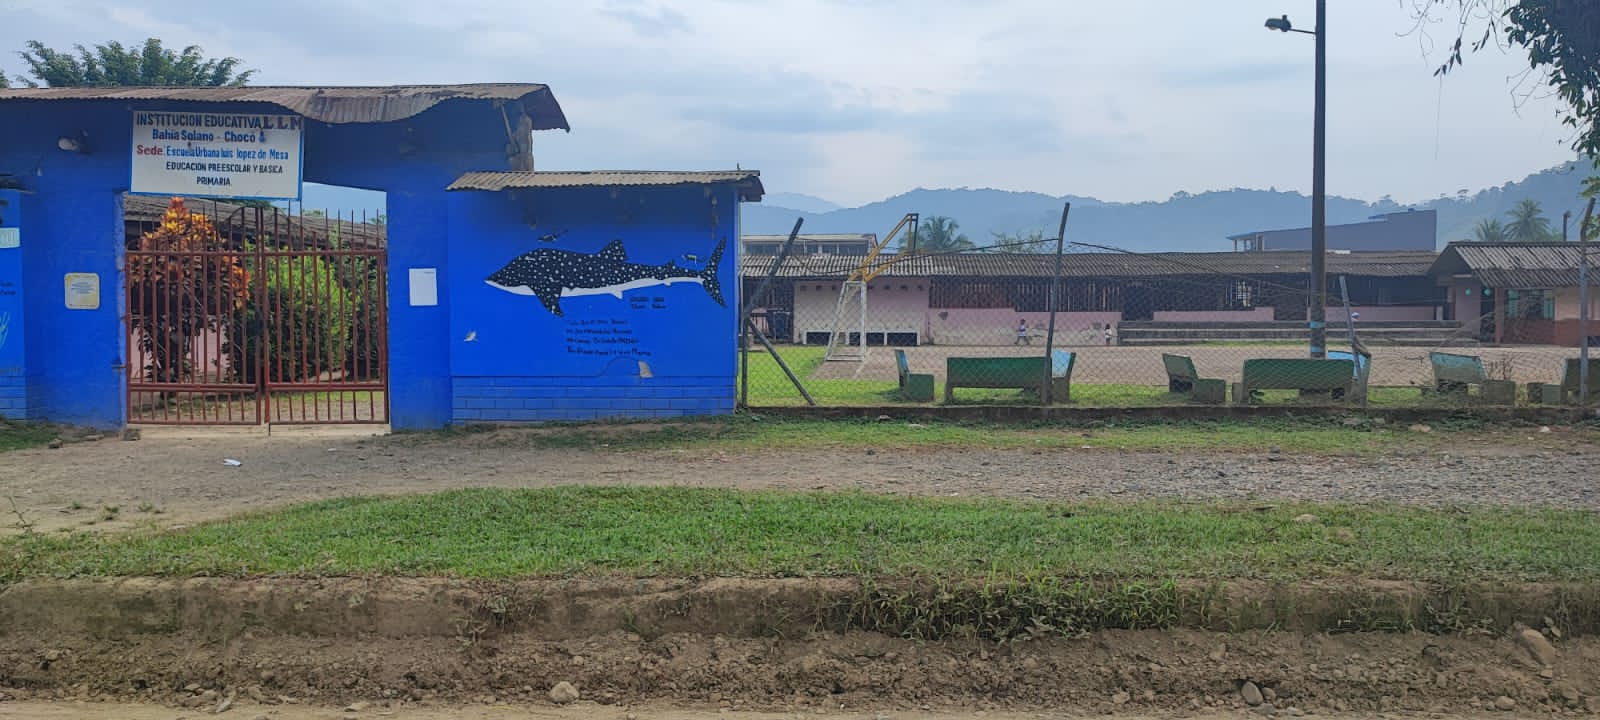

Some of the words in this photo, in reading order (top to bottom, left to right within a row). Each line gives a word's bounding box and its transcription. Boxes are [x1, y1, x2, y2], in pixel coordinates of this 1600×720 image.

[136, 113, 202, 127] INSTITUCION
[204, 115, 261, 129] EDUCATIVA
[181, 129, 214, 142] Solano
[136, 144, 163, 156] Sede
[166, 161, 207, 172] EDUCACION
[208, 163, 251, 173] PREESCOLAR
[253, 164, 258, 173] Y
[196, 176, 231, 186] PRIMARIA
